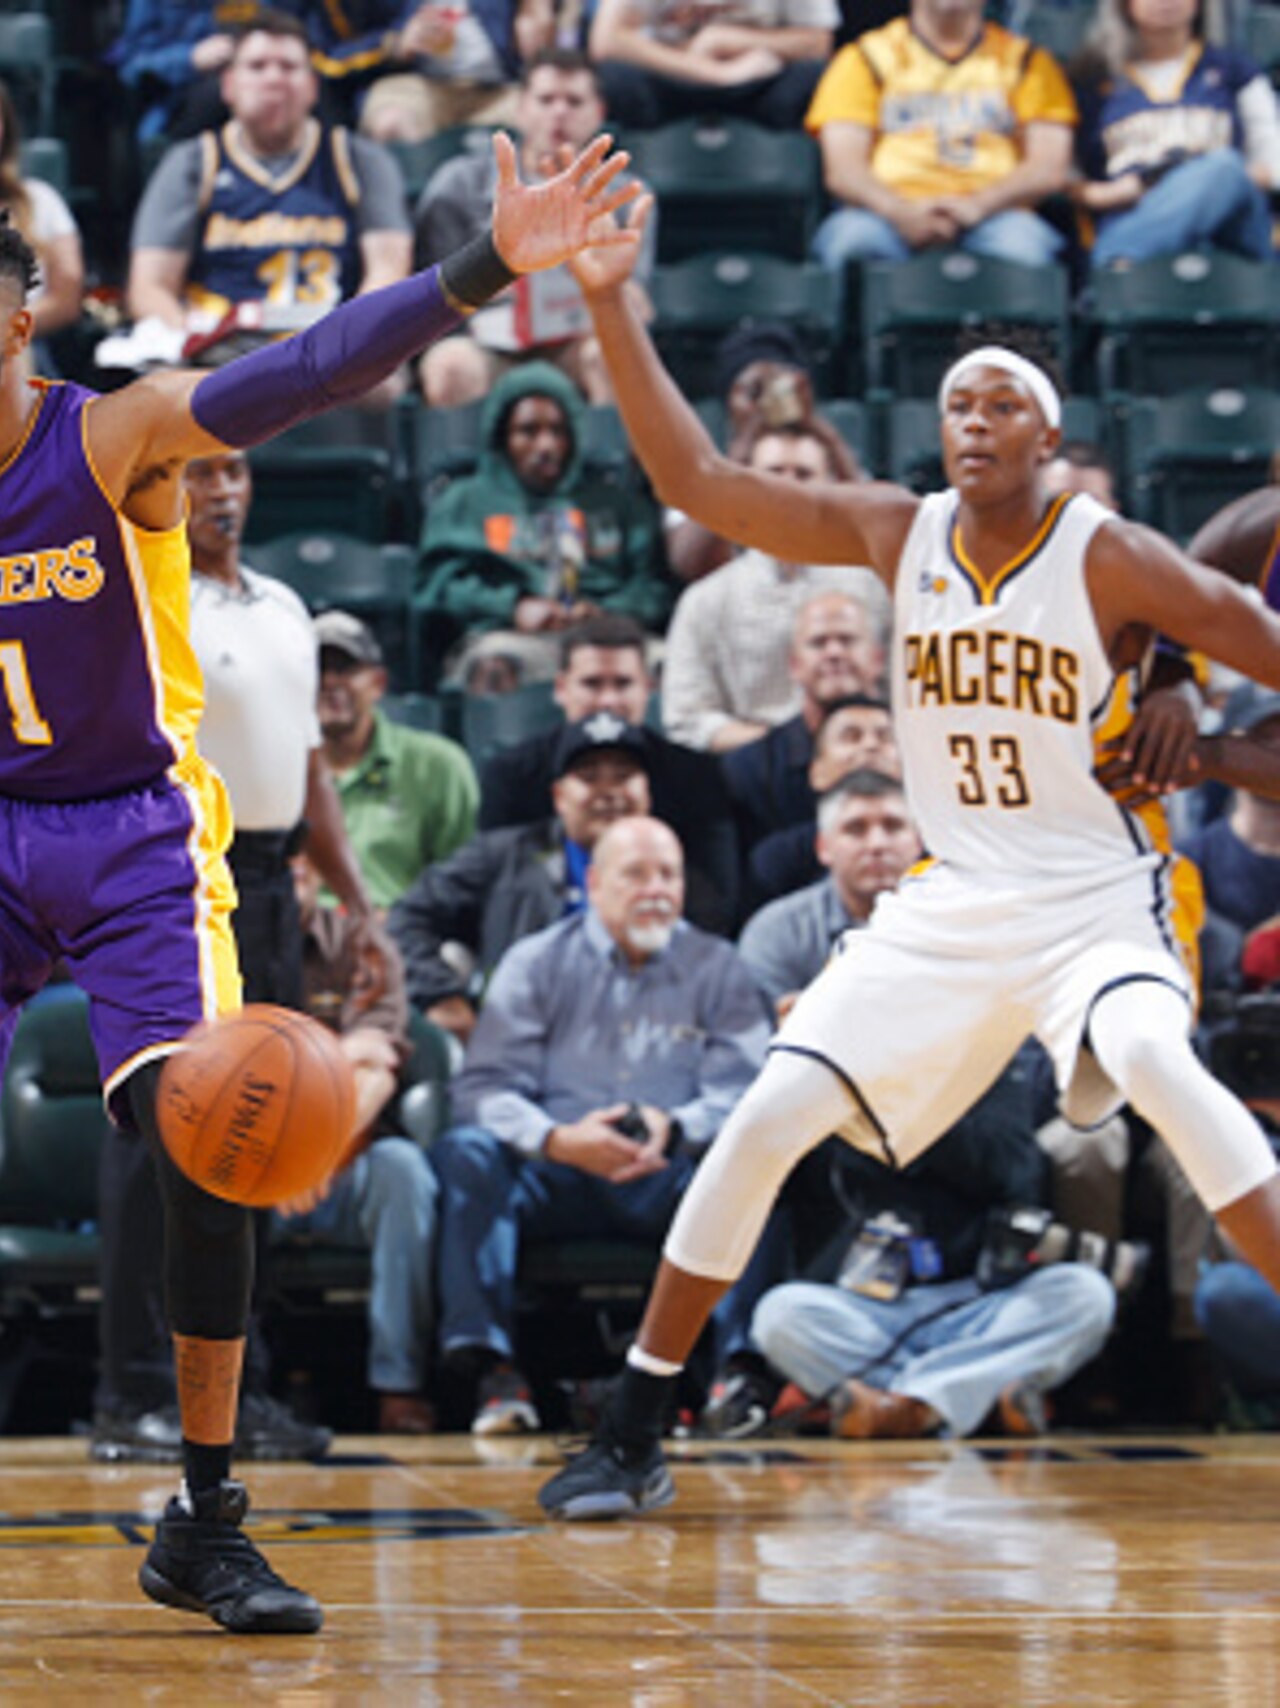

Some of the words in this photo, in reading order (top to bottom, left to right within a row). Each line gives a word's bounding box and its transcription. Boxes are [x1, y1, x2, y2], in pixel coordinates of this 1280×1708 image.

[257, 248, 341, 305] 13
[904, 630, 1079, 726] PACERS
[949, 734, 1031, 808] 33
